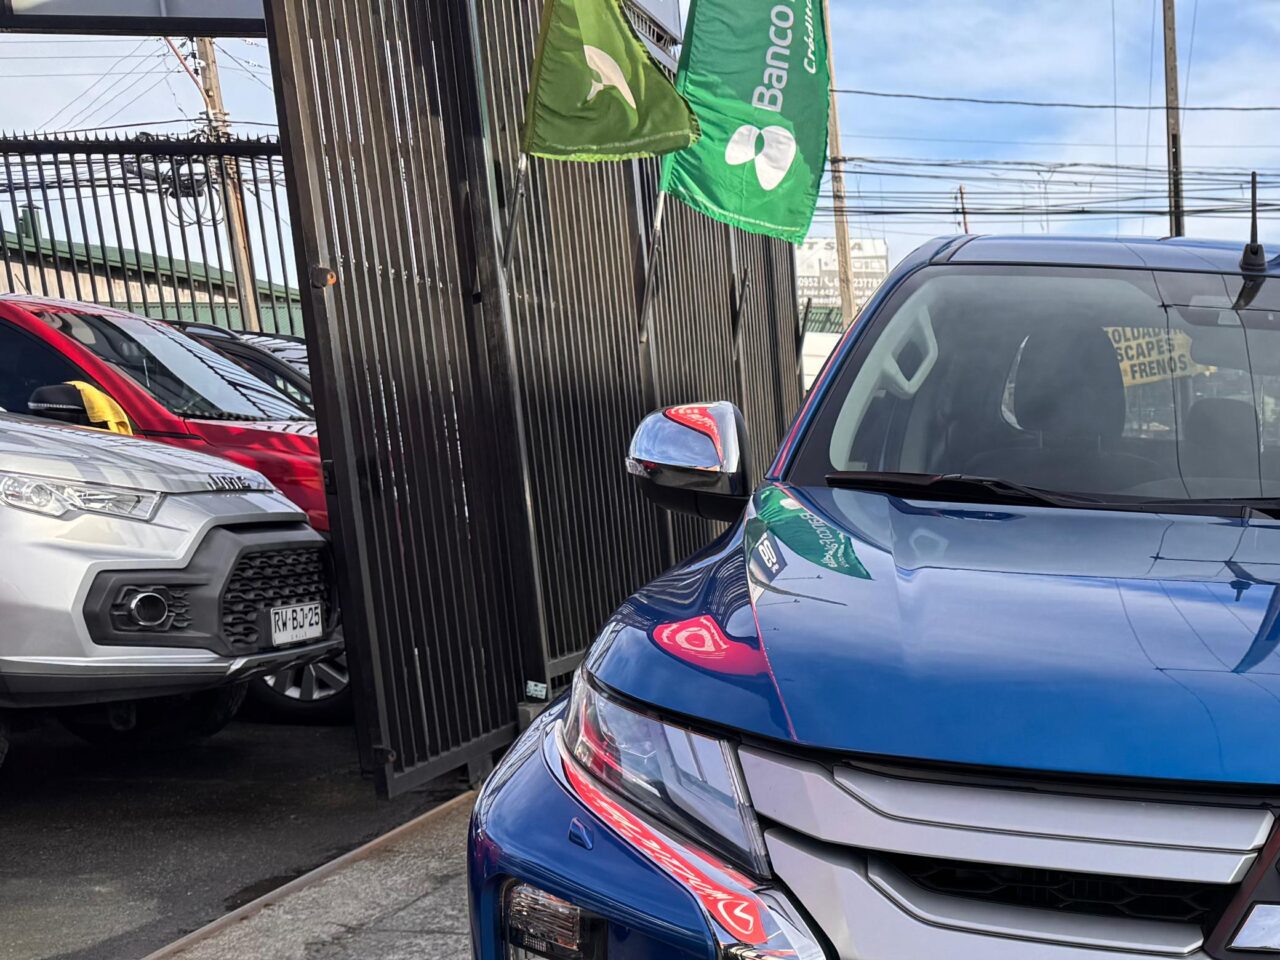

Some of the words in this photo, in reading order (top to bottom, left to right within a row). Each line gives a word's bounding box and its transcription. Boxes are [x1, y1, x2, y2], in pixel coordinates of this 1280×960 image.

[752, 4, 794, 113] Banco
[1116, 337, 1175, 362] SCAPES
[1130, 353, 1188, 380] FRENOS
